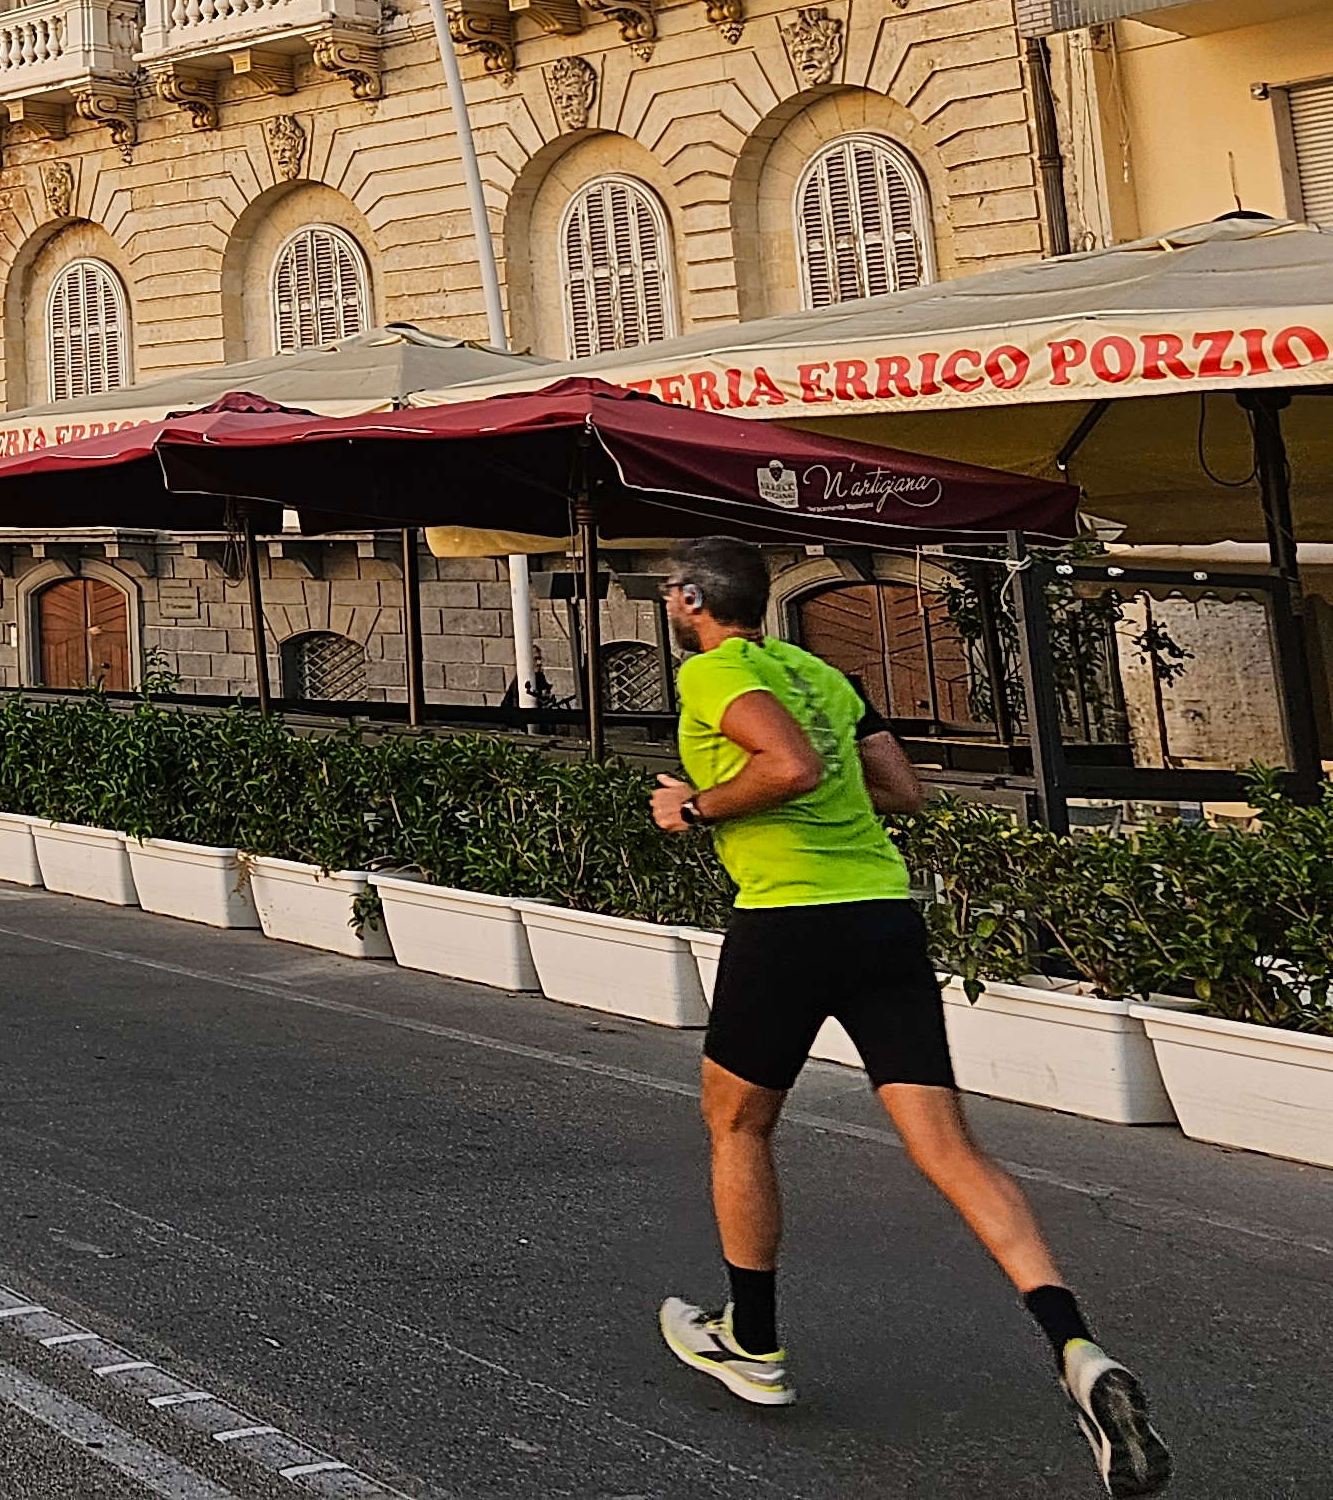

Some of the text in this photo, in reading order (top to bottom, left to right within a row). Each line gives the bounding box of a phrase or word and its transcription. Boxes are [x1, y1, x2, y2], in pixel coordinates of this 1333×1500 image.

[613, 325, 1330, 411] ERIA ERRICO PORZIO
[55, 419, 151, 447] ERR
